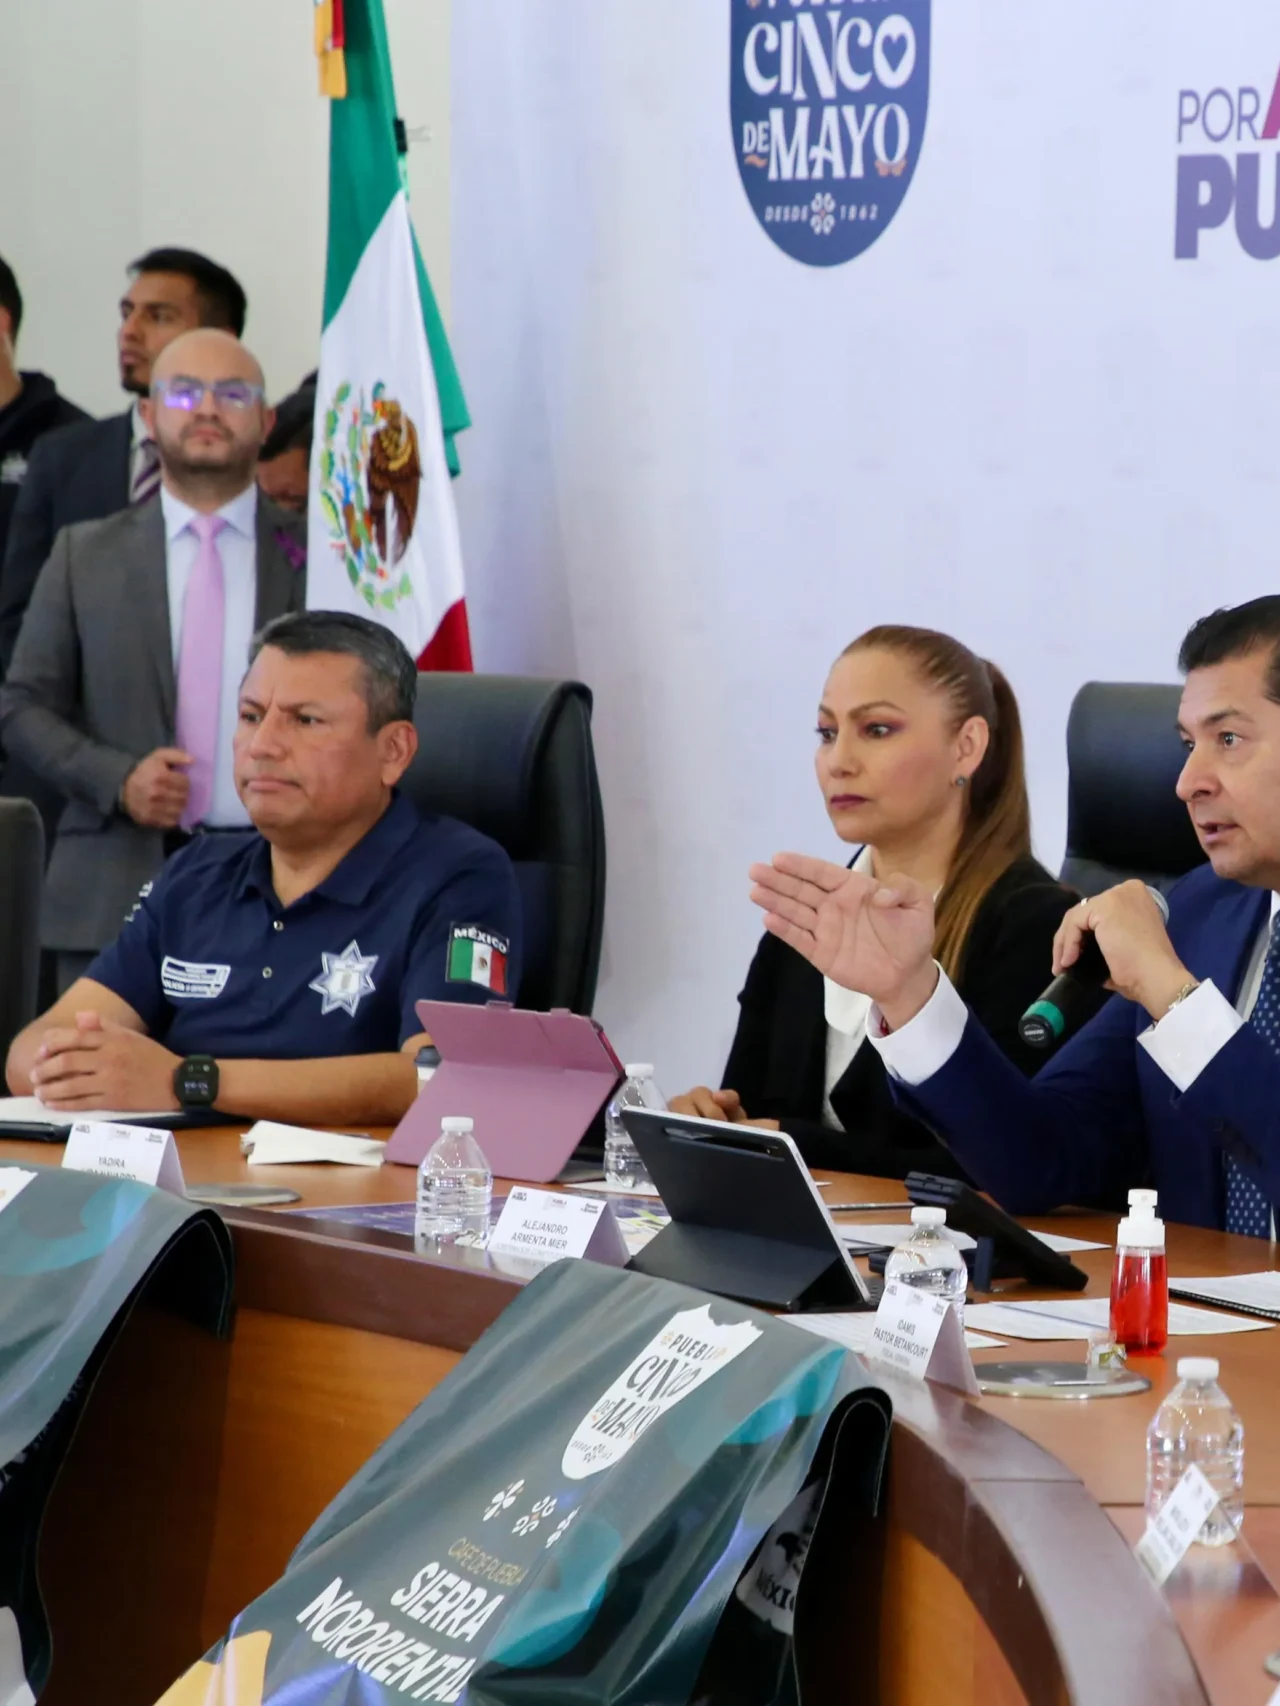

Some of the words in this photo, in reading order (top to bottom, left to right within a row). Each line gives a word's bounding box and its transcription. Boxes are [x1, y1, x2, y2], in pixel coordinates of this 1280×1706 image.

[743, 11, 917, 100] CINCO
[743, 121, 770, 153] DE
[768, 103, 910, 181] MAYO
[1177, 87, 1261, 143] POR
[454, 926, 507, 954] MÉXICO
[511, 1232, 548, 1247] ARMENTA
[548, 1238, 568, 1250] MIER
[521, 1219, 568, 1235] ALEJANDRO
[873, 1327, 895, 1345] PASTOR
[893, 1335, 929, 1359] BETANCOURT
[390, 1561, 505, 1643] SIERRA
[295, 1576, 478, 1704] NORORIENTAL
